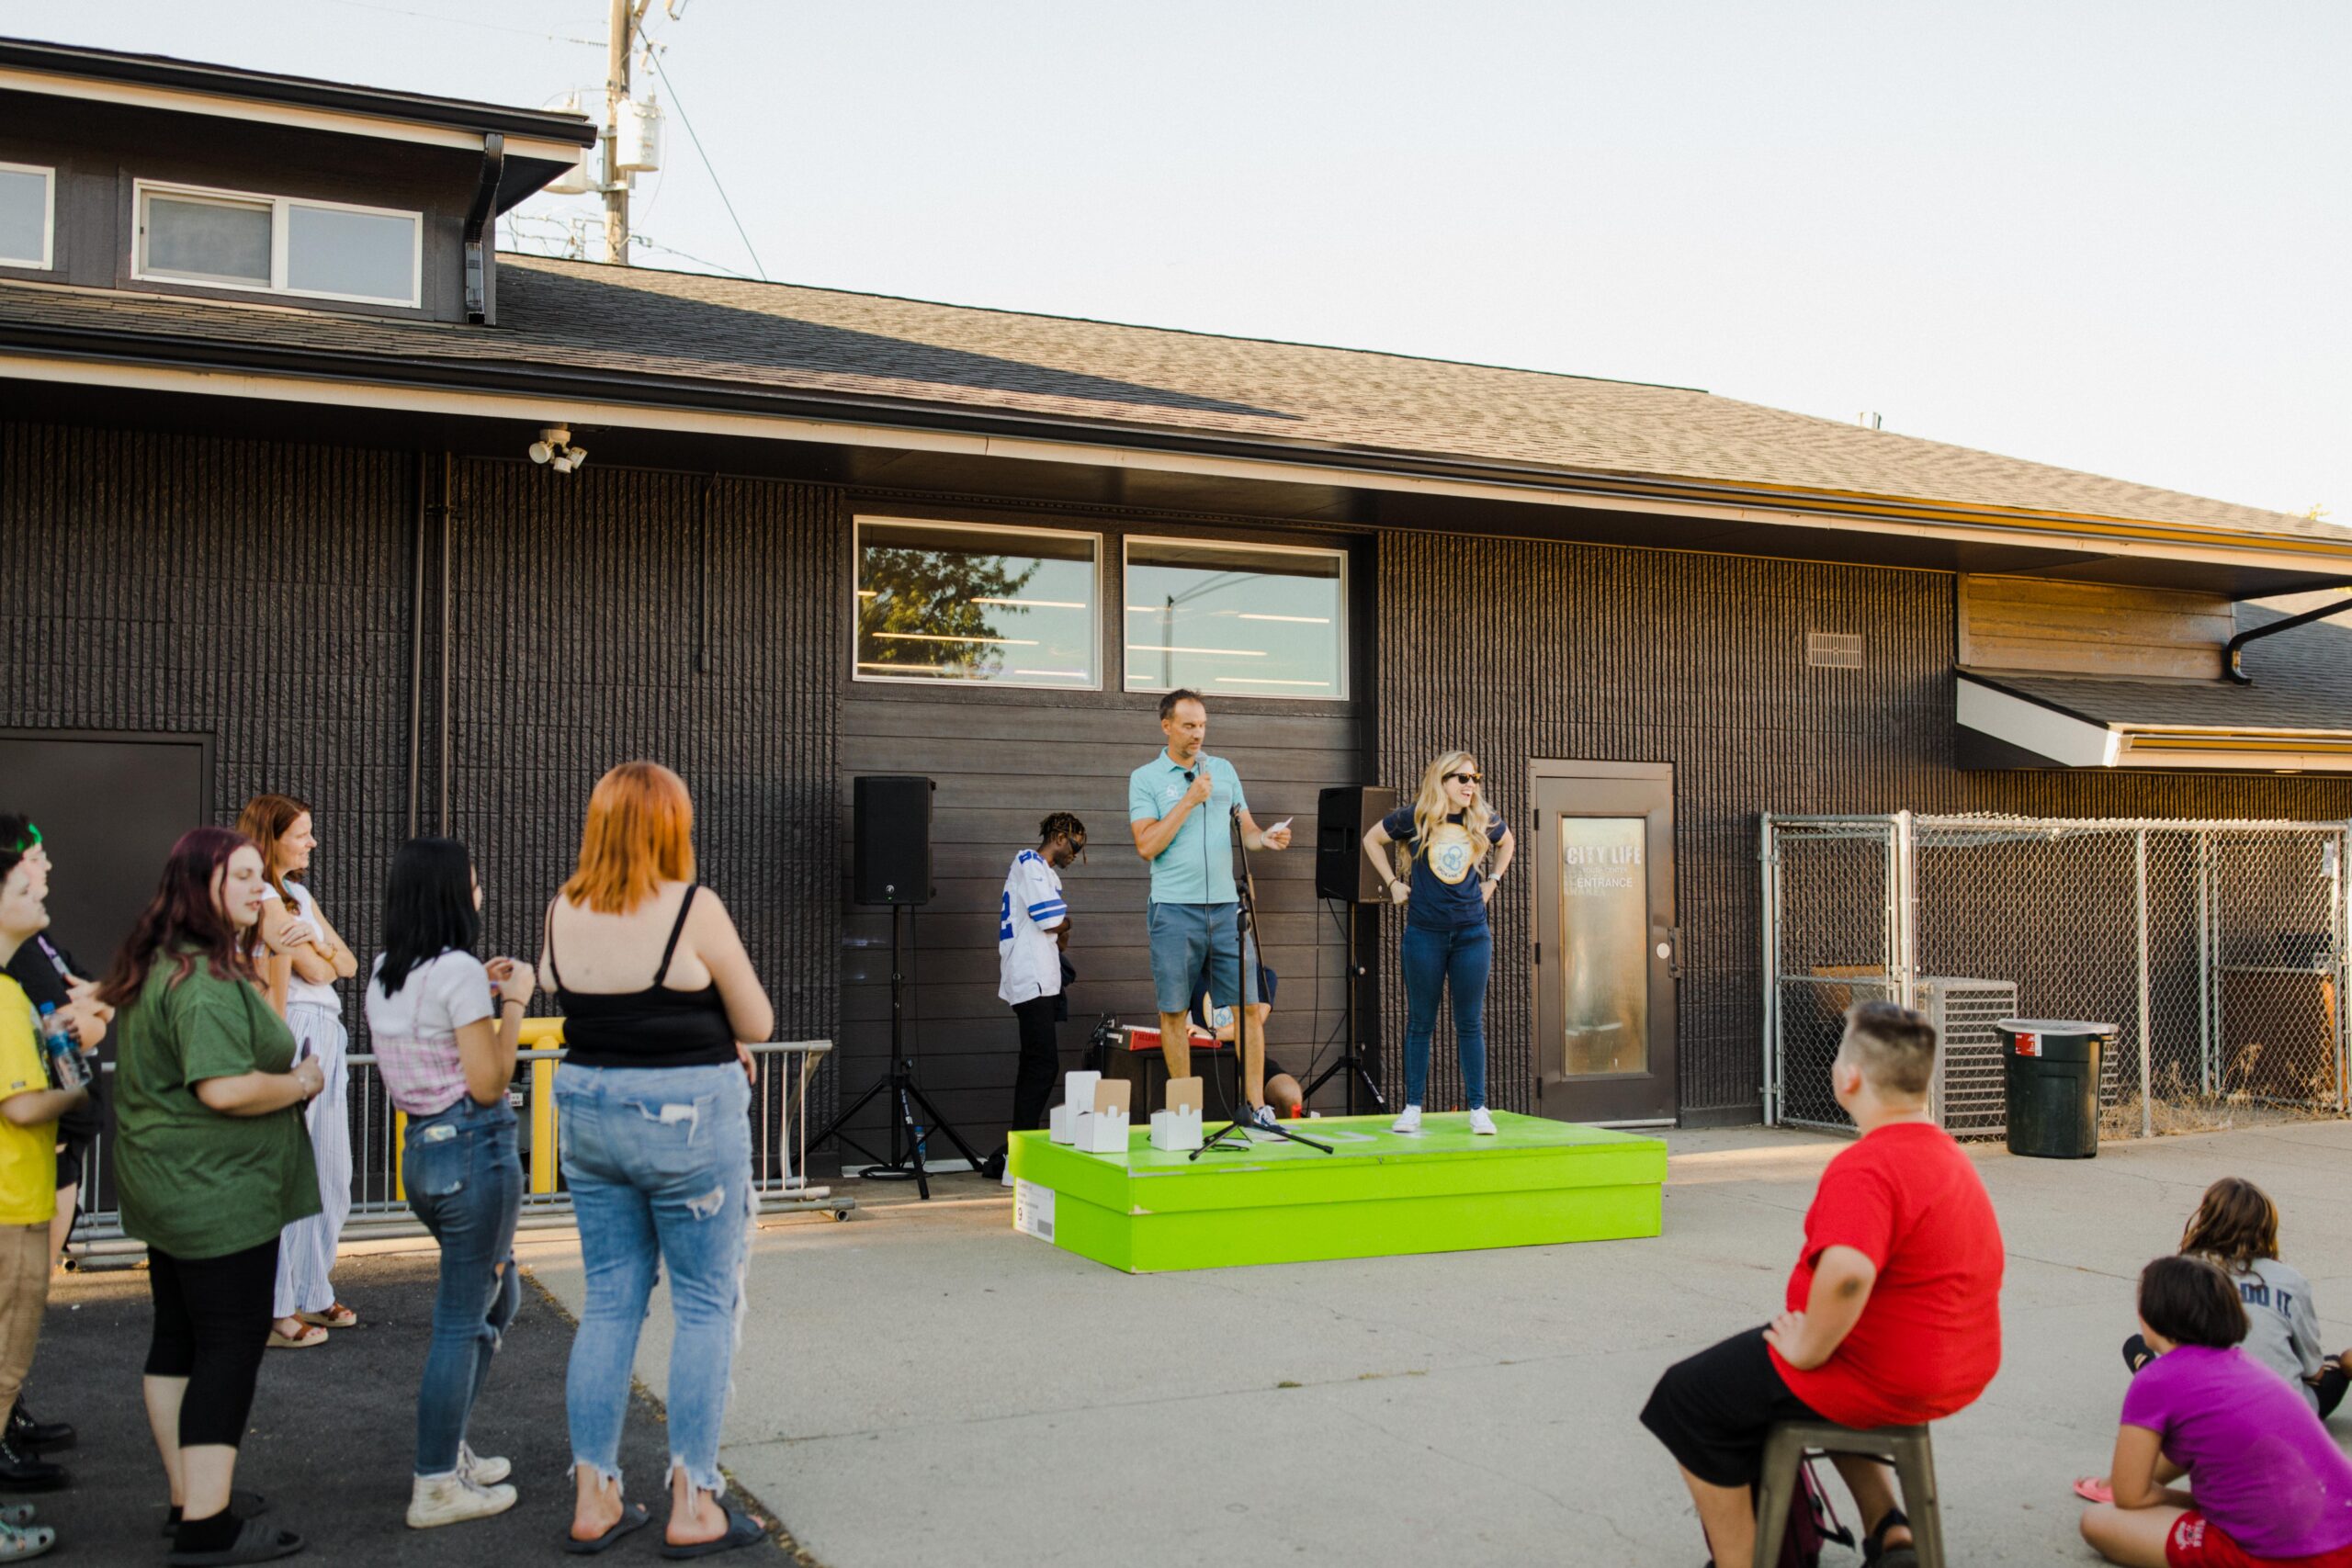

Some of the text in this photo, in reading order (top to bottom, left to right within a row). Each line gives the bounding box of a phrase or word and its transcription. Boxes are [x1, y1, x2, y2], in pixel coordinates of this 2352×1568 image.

[1566, 846, 1641, 864] CITY LIFE
[1577, 877, 1633, 888] ENTRANCE
[2240, 1282, 2269, 1307] DO
